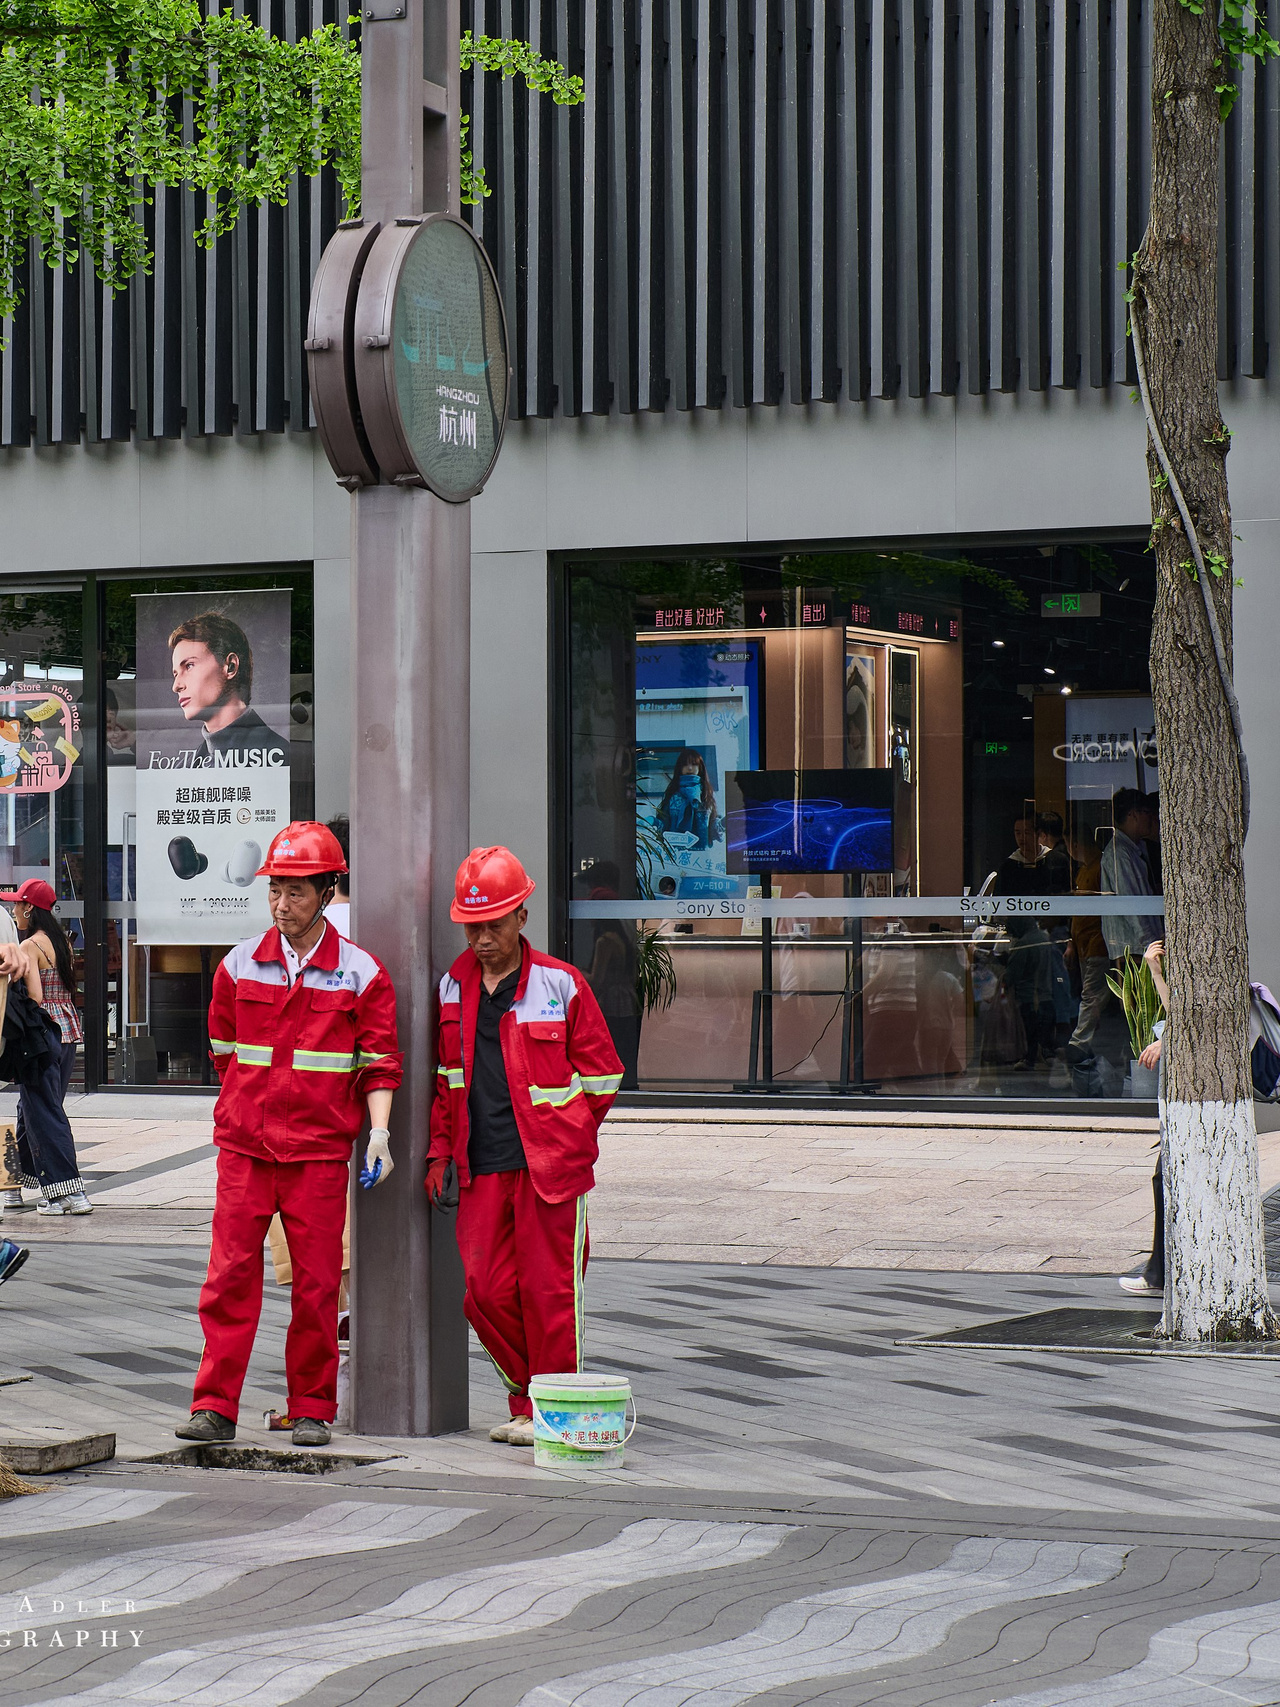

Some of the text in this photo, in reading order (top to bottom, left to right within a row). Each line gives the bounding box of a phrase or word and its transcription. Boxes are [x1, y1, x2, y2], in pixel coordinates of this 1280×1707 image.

[436, 384, 479, 405] HANGZHOU
[439, 404, 477, 449] 杭州
[655, 608, 724, 627] 直出好看 好出片
[18, 683, 41, 692] Store
[51, 684, 73, 702] noko
[71, 704, 81, 732] noko
[148, 748, 285, 770] For The MUSIC
[175, 787, 252, 803] 超旗舰降噪
[156, 808, 232, 825] 殿堂级音质
[676, 901, 715, 918] Sony
[1006, 897, 1051, 912] Store
